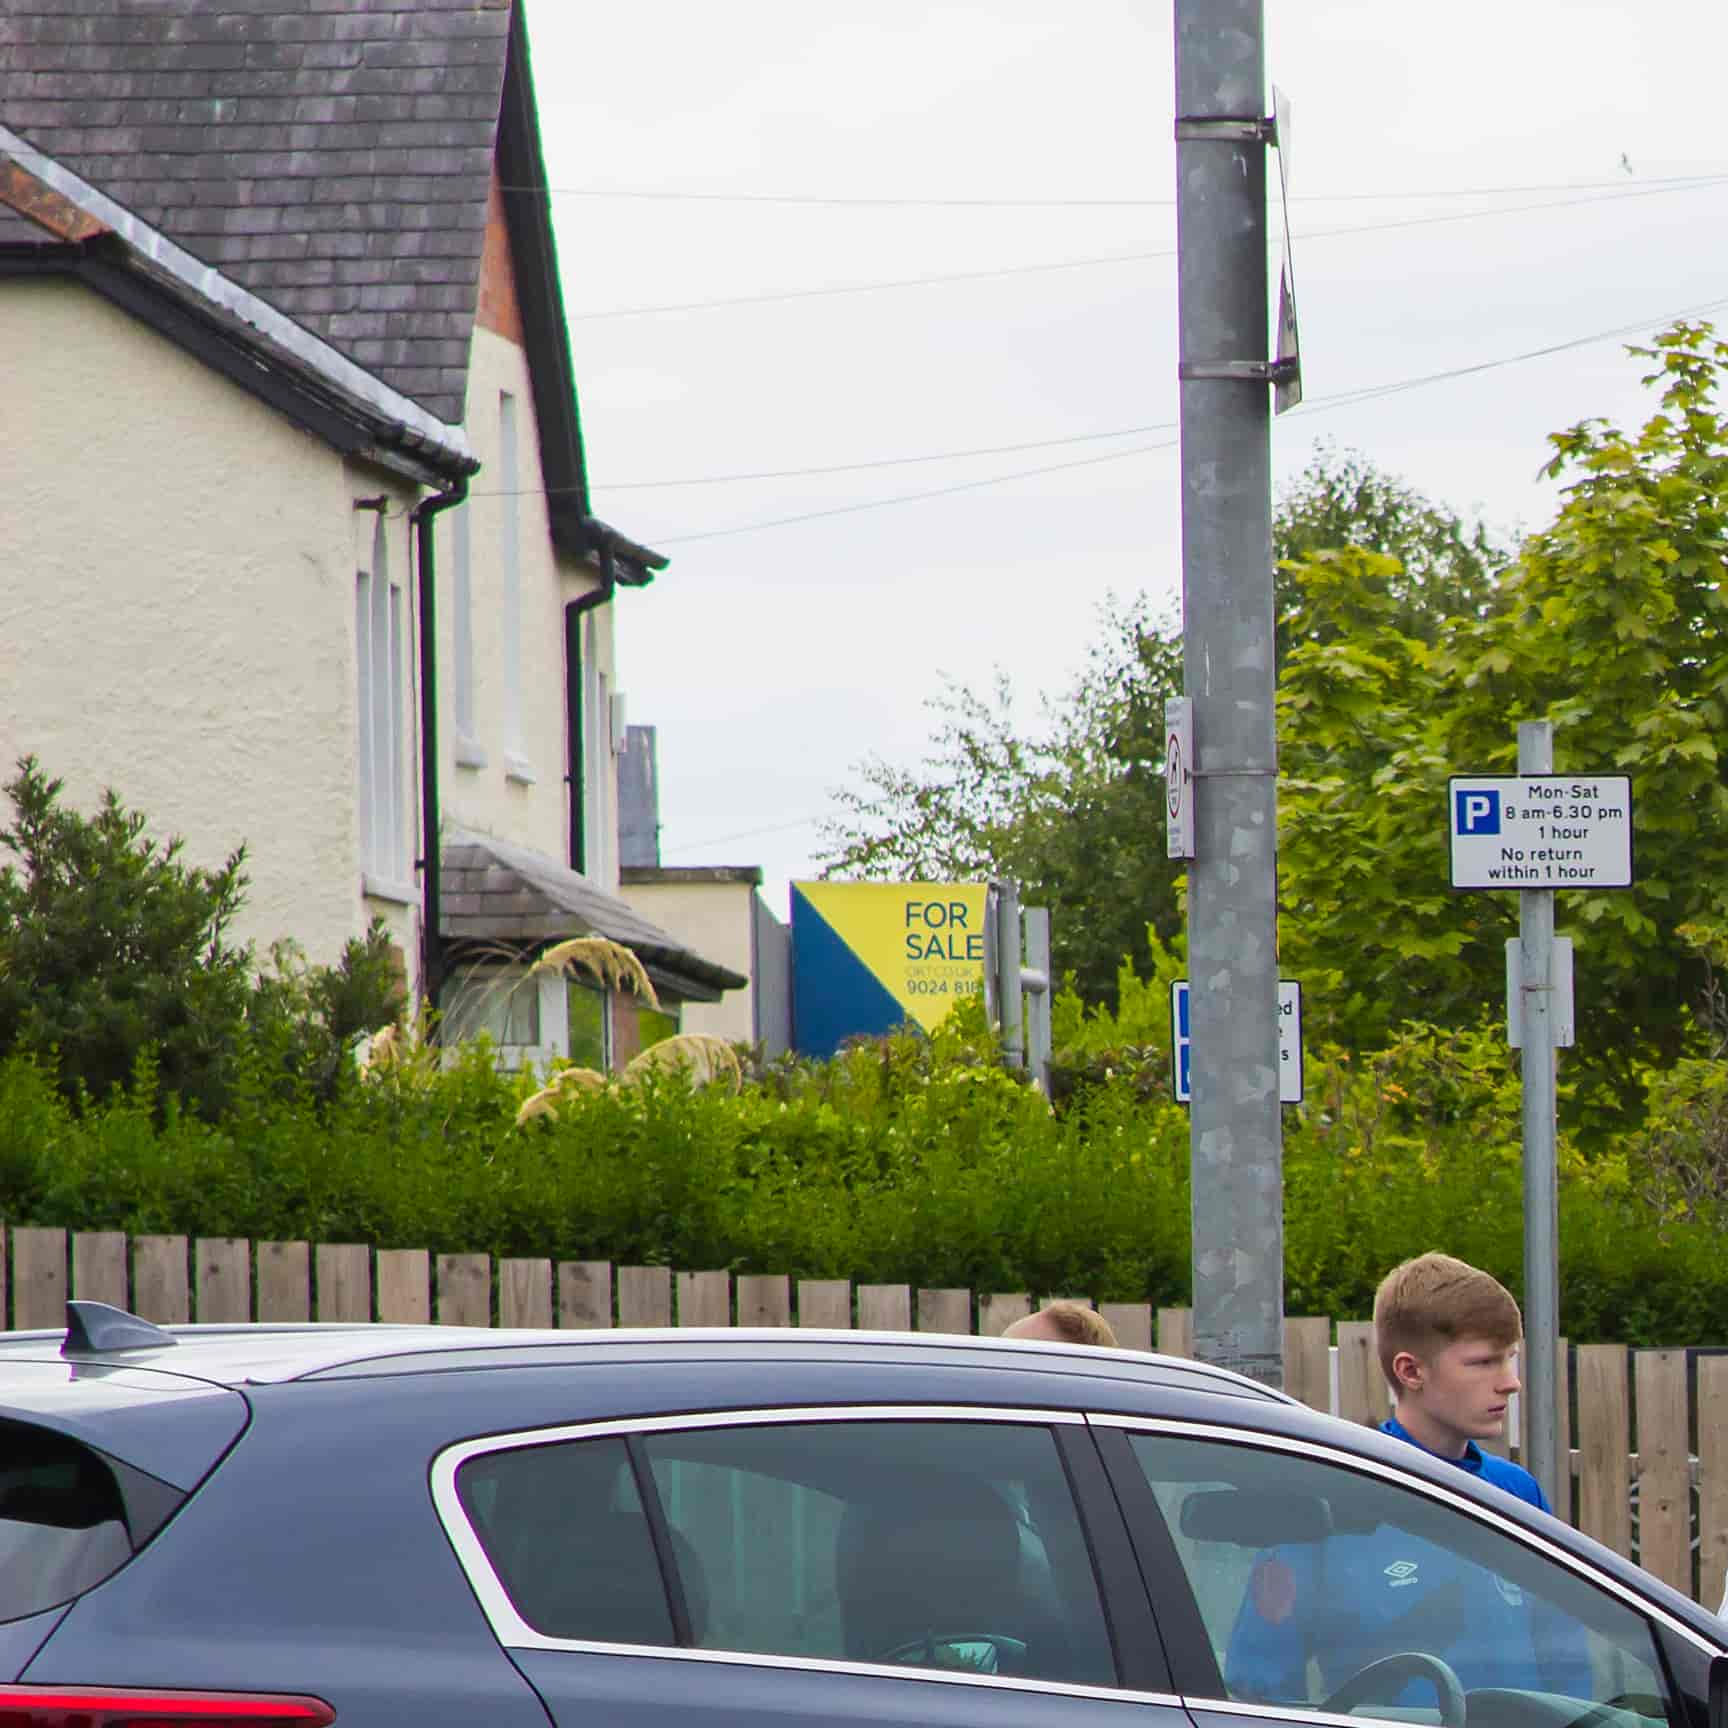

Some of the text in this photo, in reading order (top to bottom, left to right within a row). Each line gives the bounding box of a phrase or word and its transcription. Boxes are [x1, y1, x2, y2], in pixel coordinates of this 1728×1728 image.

[1528, 785, 1600, 800] Mon-Sat
[1466, 796, 1491, 831] P
[1505, 806, 1516, 820] 8
[1598, 807, 1623, 823] pm
[1539, 825, 1589, 840] 1 hour
[1501, 848, 1582, 862] No return
[1488, 864, 1595, 880] within 1 hour
[905, 901, 968, 929] FOR
[905, 934, 984, 960] SALE
[907, 979, 948, 995] 9024
